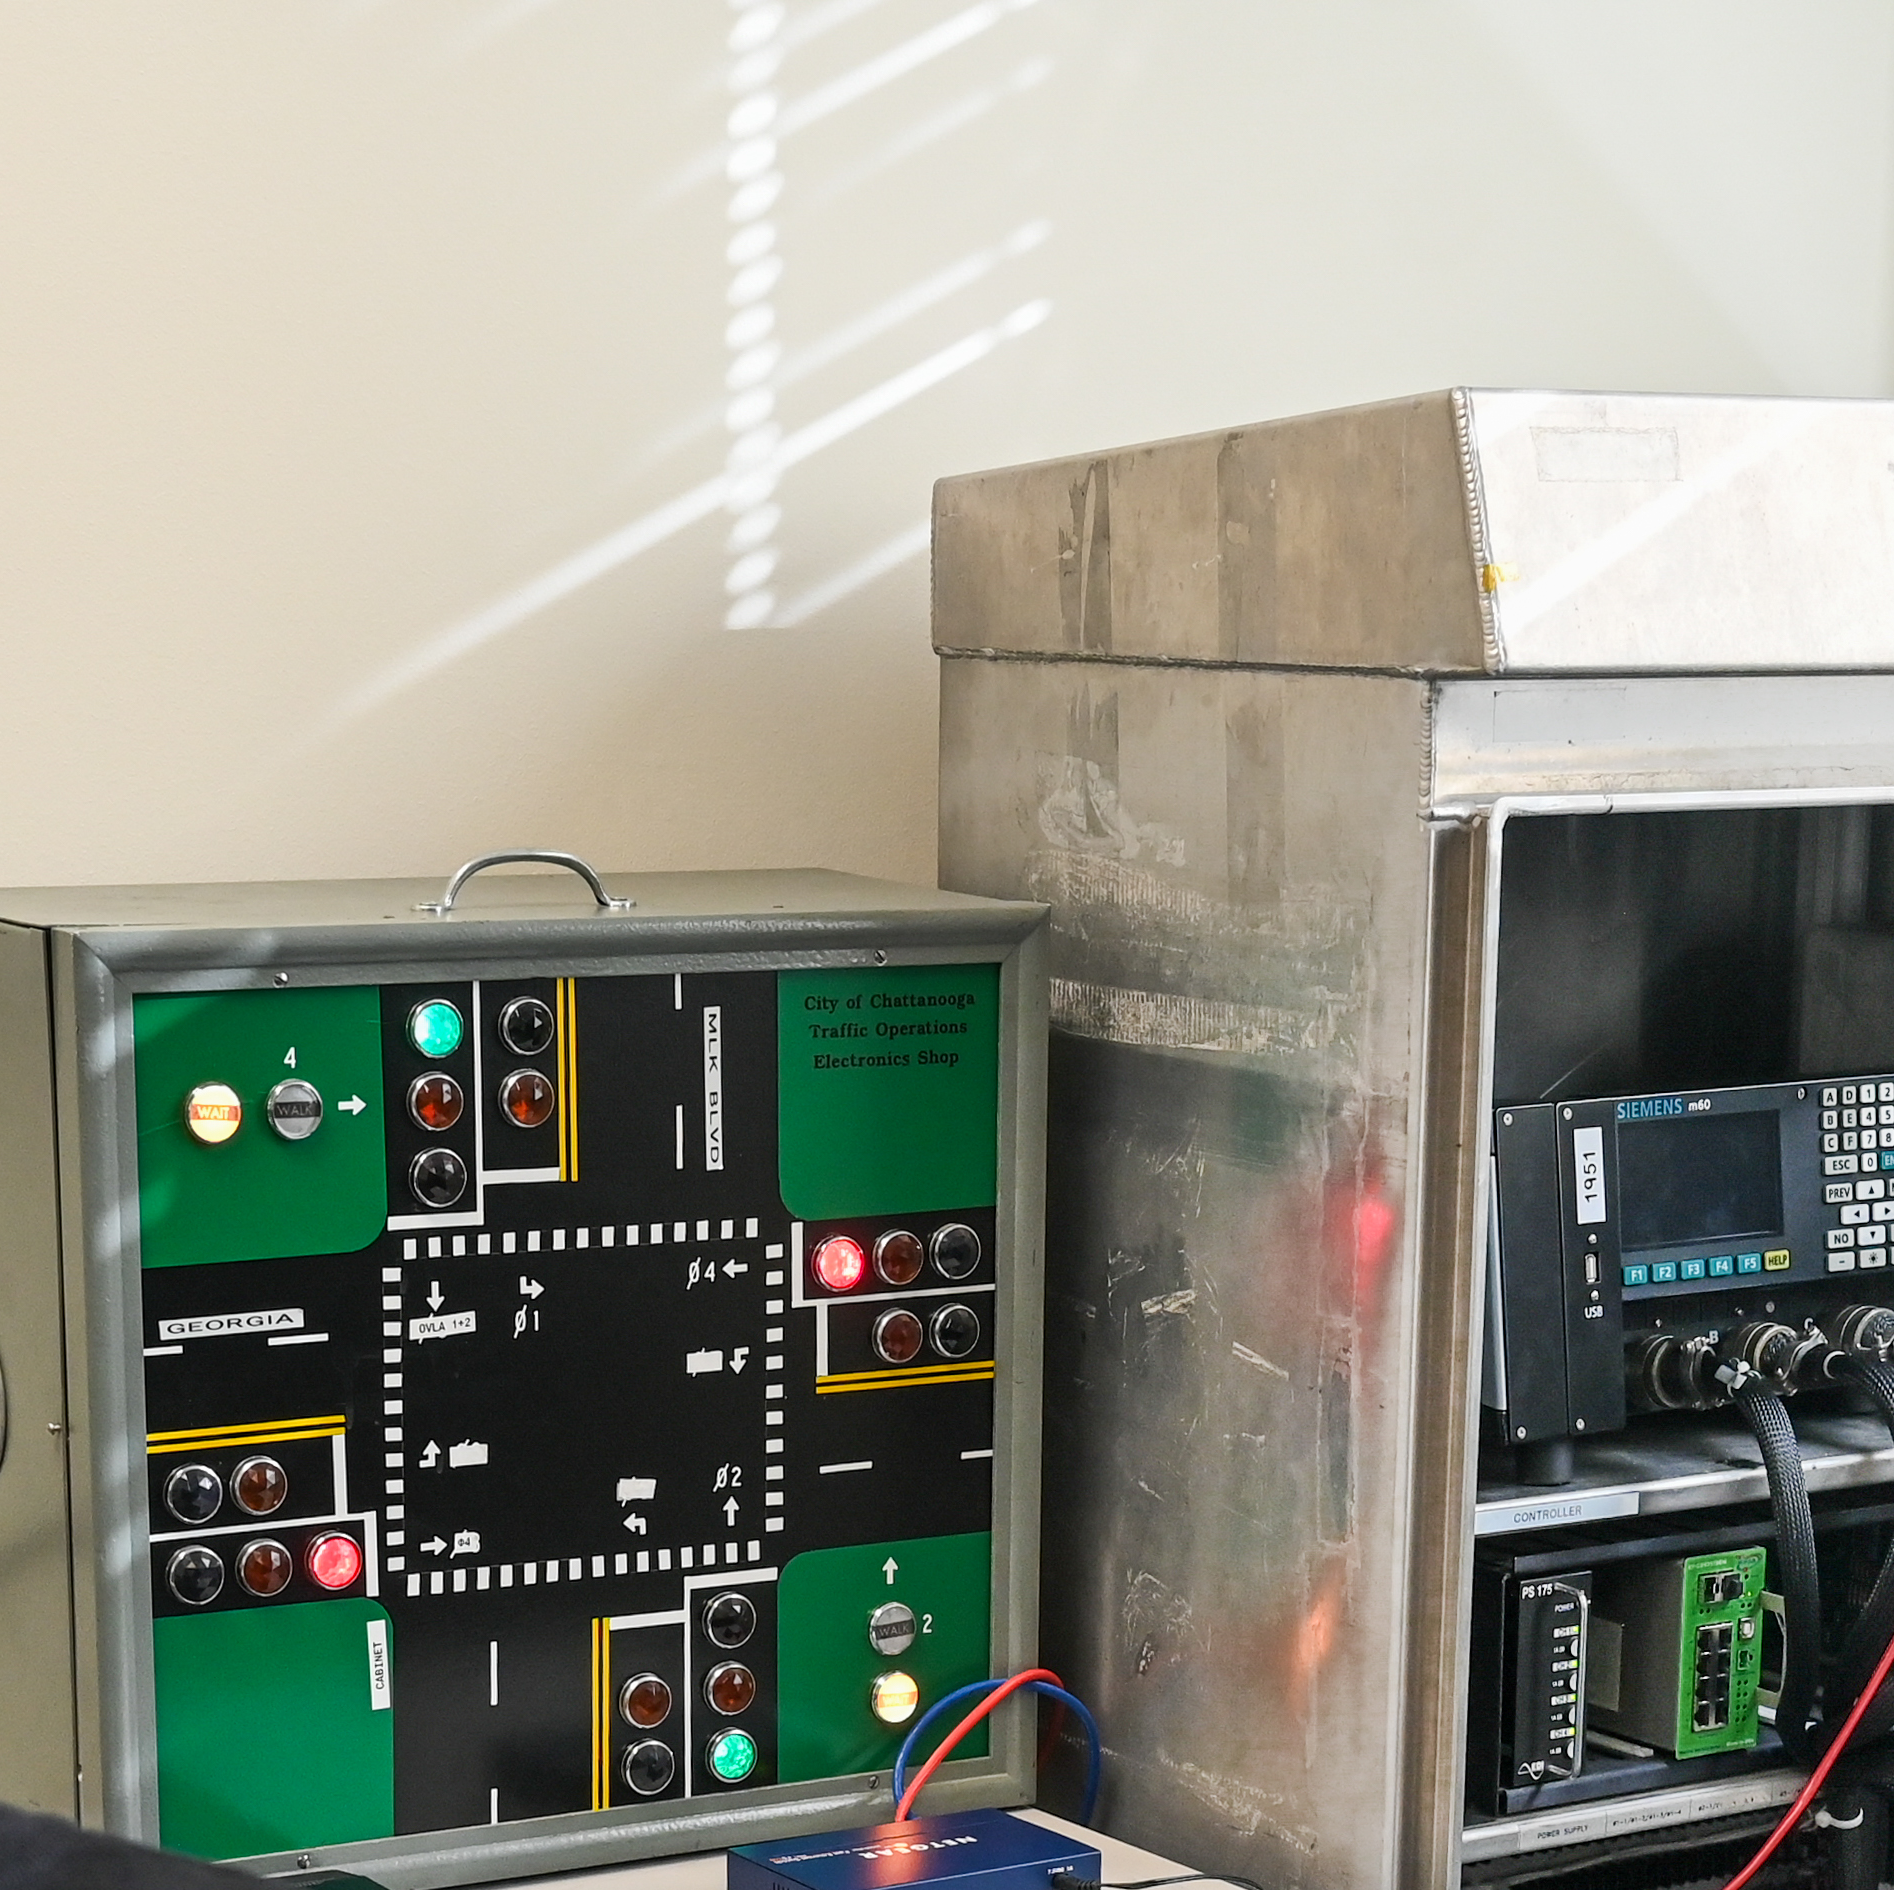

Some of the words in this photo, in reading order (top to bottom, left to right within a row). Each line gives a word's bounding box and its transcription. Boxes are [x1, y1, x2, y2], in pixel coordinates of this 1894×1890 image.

[804, 995, 838, 1014] City
[846, 994, 862, 1010] of
[870, 992, 975, 1009] Chattanooga
[808, 1023, 868, 1039] Traffic
[875, 1020, 968, 1040] Operations
[708, 1013, 719, 1073] MLK
[283, 1046, 297, 1069] 4
[813, 1053, 910, 1070] Electronics
[917, 1050, 959, 1067] Shop
[1827, 1092, 1834, 1102] A
[1846, 1090, 1853, 1101] D
[1866, 1089, 1871, 1099] 1
[1885, 1087, 1891, 1097] 2
[196, 1105, 231, 1120] WAIT
[276, 1104, 313, 1116] WALK
[1617, 1098, 1684, 1120] SIEMENS
[1688, 1099, 1711, 1111] m60
[1885, 1110, 1891, 1120] 5
[1827, 1115, 1834, 1125] B
[1847, 1113, 1853, 1124] E
[1866, 1112, 1872, 1122] 4
[709, 1091, 720, 1164] BLVD
[1828, 1138, 1835, 1149] C
[1847, 1136, 1853, 1146] F
[1867, 1134, 1872, 1144] 7
[1886, 1132, 1892, 1142] 8
[1832, 1159, 1851, 1171] ESC
[1867, 1157, 1873, 1167] 0
[1583, 1151, 1598, 1203] 1951
[1828, 1187, 1851, 1198] PREV
[1834, 1233, 1849, 1244] NO
[1715, 1260, 1729, 1273] F4
[1744, 1257, 1757, 1270] F5
[1768, 1254, 1788, 1266] HELP
[1631, 1269, 1643, 1282] F1
[1659, 1267, 1672, 1278] F2
[1687, 1264, 1700, 1275] F3
[1584, 1305, 1604, 1319] USB
[166, 1312, 295, 1336] GEORGIA
[418, 1321, 446, 1334] OVLA
[452, 1316, 471, 1330] 1+2
[1708, 1329, 1719, 1344] B
[1513, 1504, 1583, 1524] CONTROLLER
[1521, 1587, 1535, 1600] PS
[1536, 1583, 1553, 1597] 175
[922, 1613, 933, 1634] 2
[879, 1624, 910, 1637] WALK
[372, 1641, 385, 1690] CABINET
[1537, 1829, 1560, 1840] POWER
[1563, 1825, 1589, 1836] SUPPLY
[859, 1834, 978, 1860] NETGEAR
